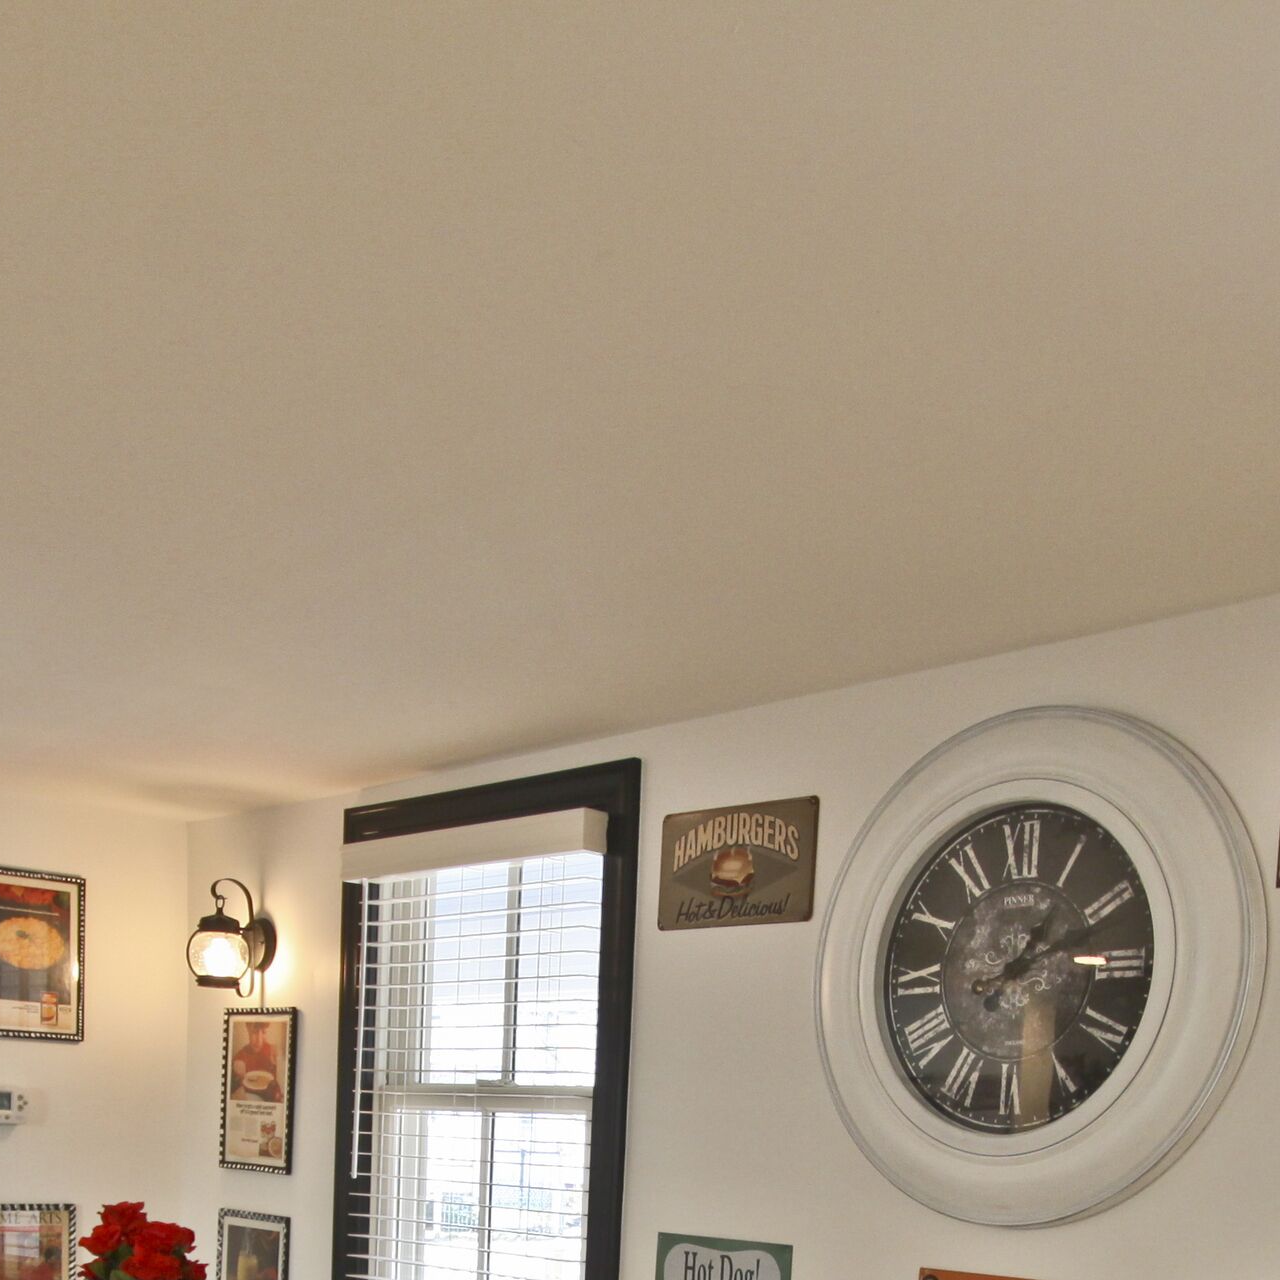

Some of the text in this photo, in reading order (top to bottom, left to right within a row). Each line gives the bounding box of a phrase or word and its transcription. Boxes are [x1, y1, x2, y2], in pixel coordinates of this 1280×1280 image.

[673, 812, 800, 873] HAMBURGERS
[1002, 819, 1040, 880] XII
[948, 843, 991, 904] XI
[676, 897, 702, 924] Hot
[717, 893, 790, 920] Delicious!
[911, 900, 956, 942] X
[897, 963, 941, 996] IX
[28, 1211, 62, 1225] ARTS
